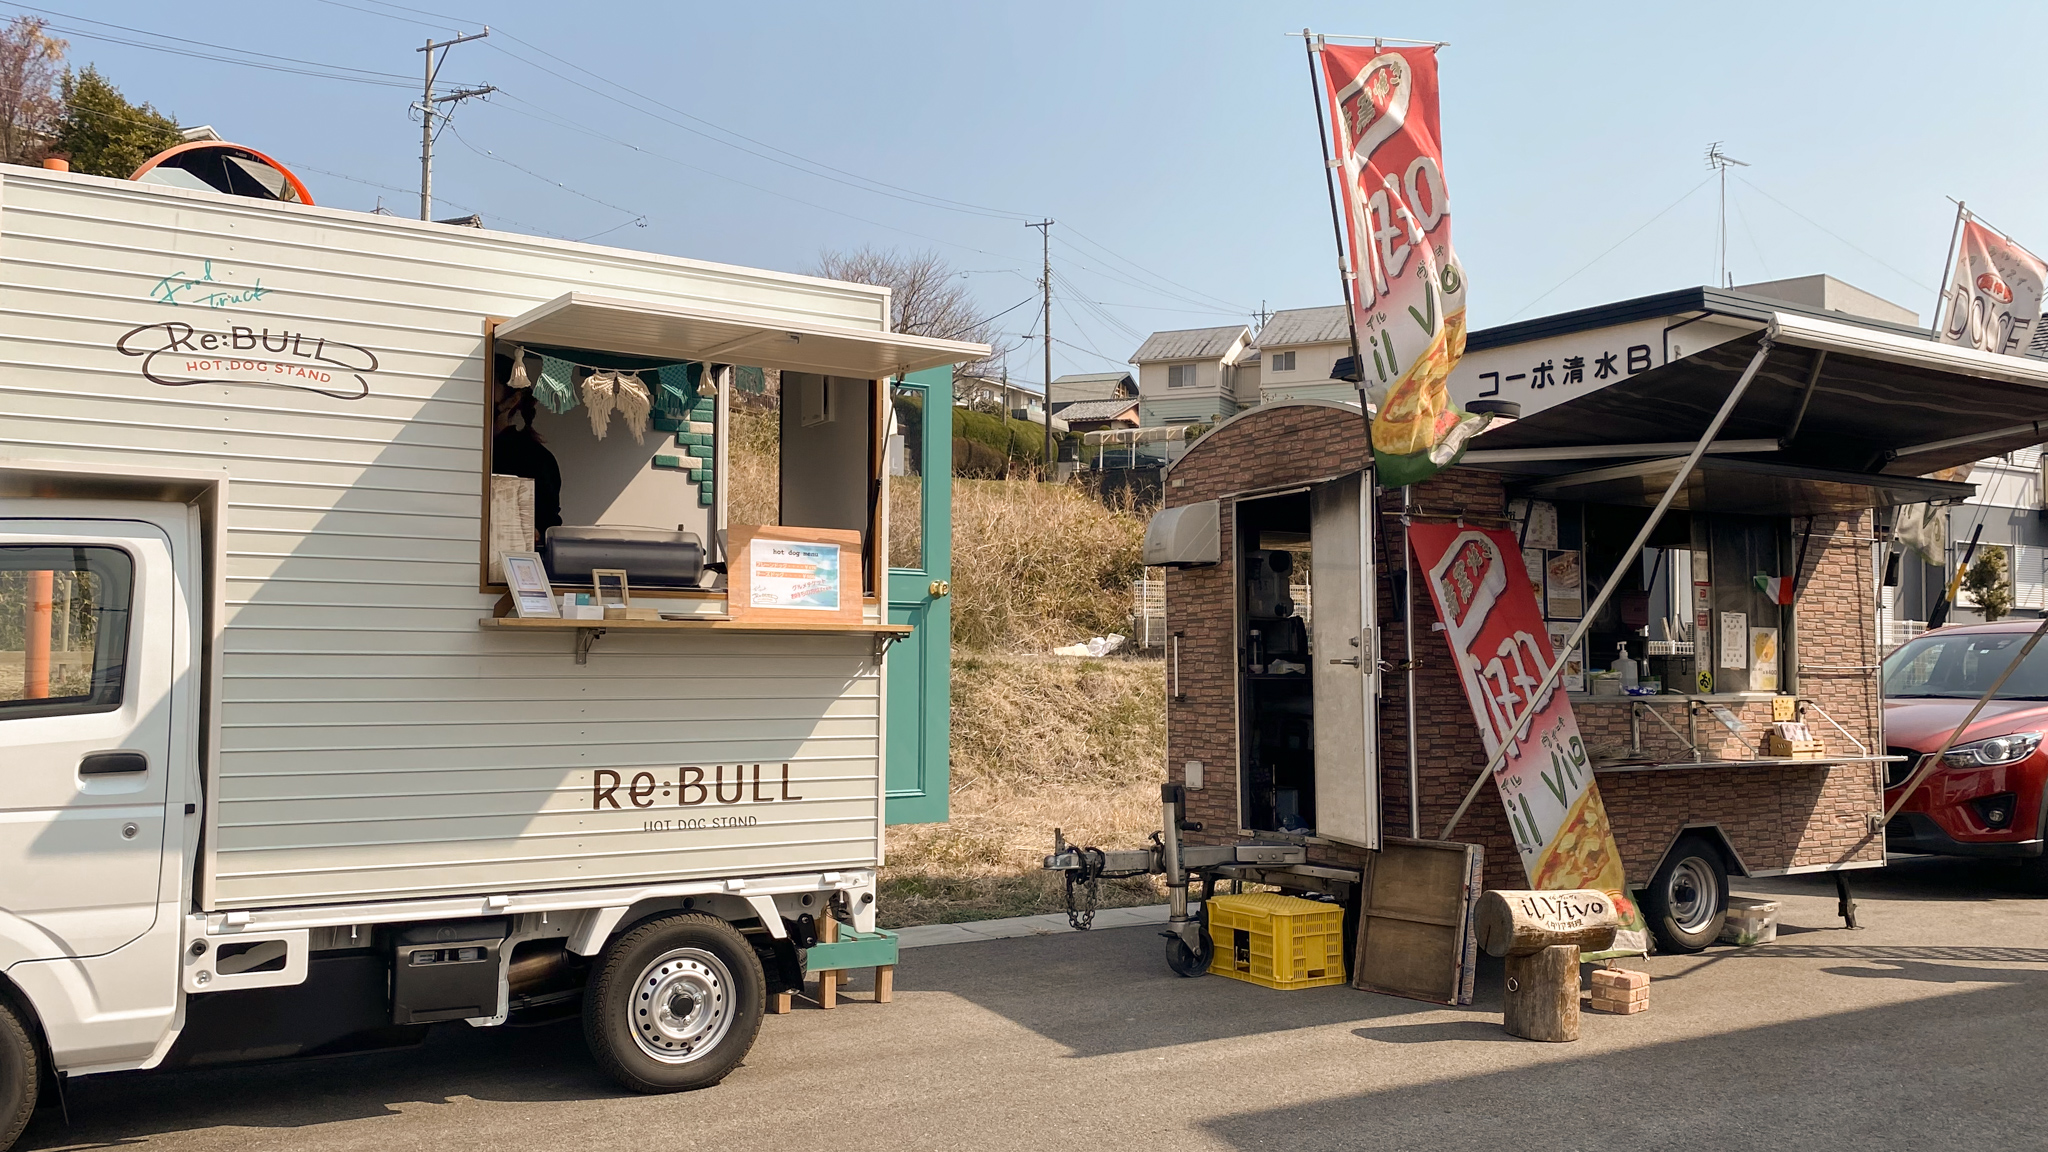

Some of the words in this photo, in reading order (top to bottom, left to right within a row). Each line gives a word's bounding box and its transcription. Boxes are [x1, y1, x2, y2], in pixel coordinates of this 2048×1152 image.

[163, 321, 329, 360] Re:BULL
[186, 360, 222, 372] HOT
[230, 361, 268, 372] DOG
[274, 363, 332, 383] STAND
[1478, 344, 1652, 398] コーポ清水B
[772, 548, 785, 556] hot
[788, 549, 800, 557] dog
[593, 763, 803, 810] Re:BULL
[643, 819, 671, 832] HOT
[678, 818, 706, 831] DOG
[712, 816, 757, 829] STAND
